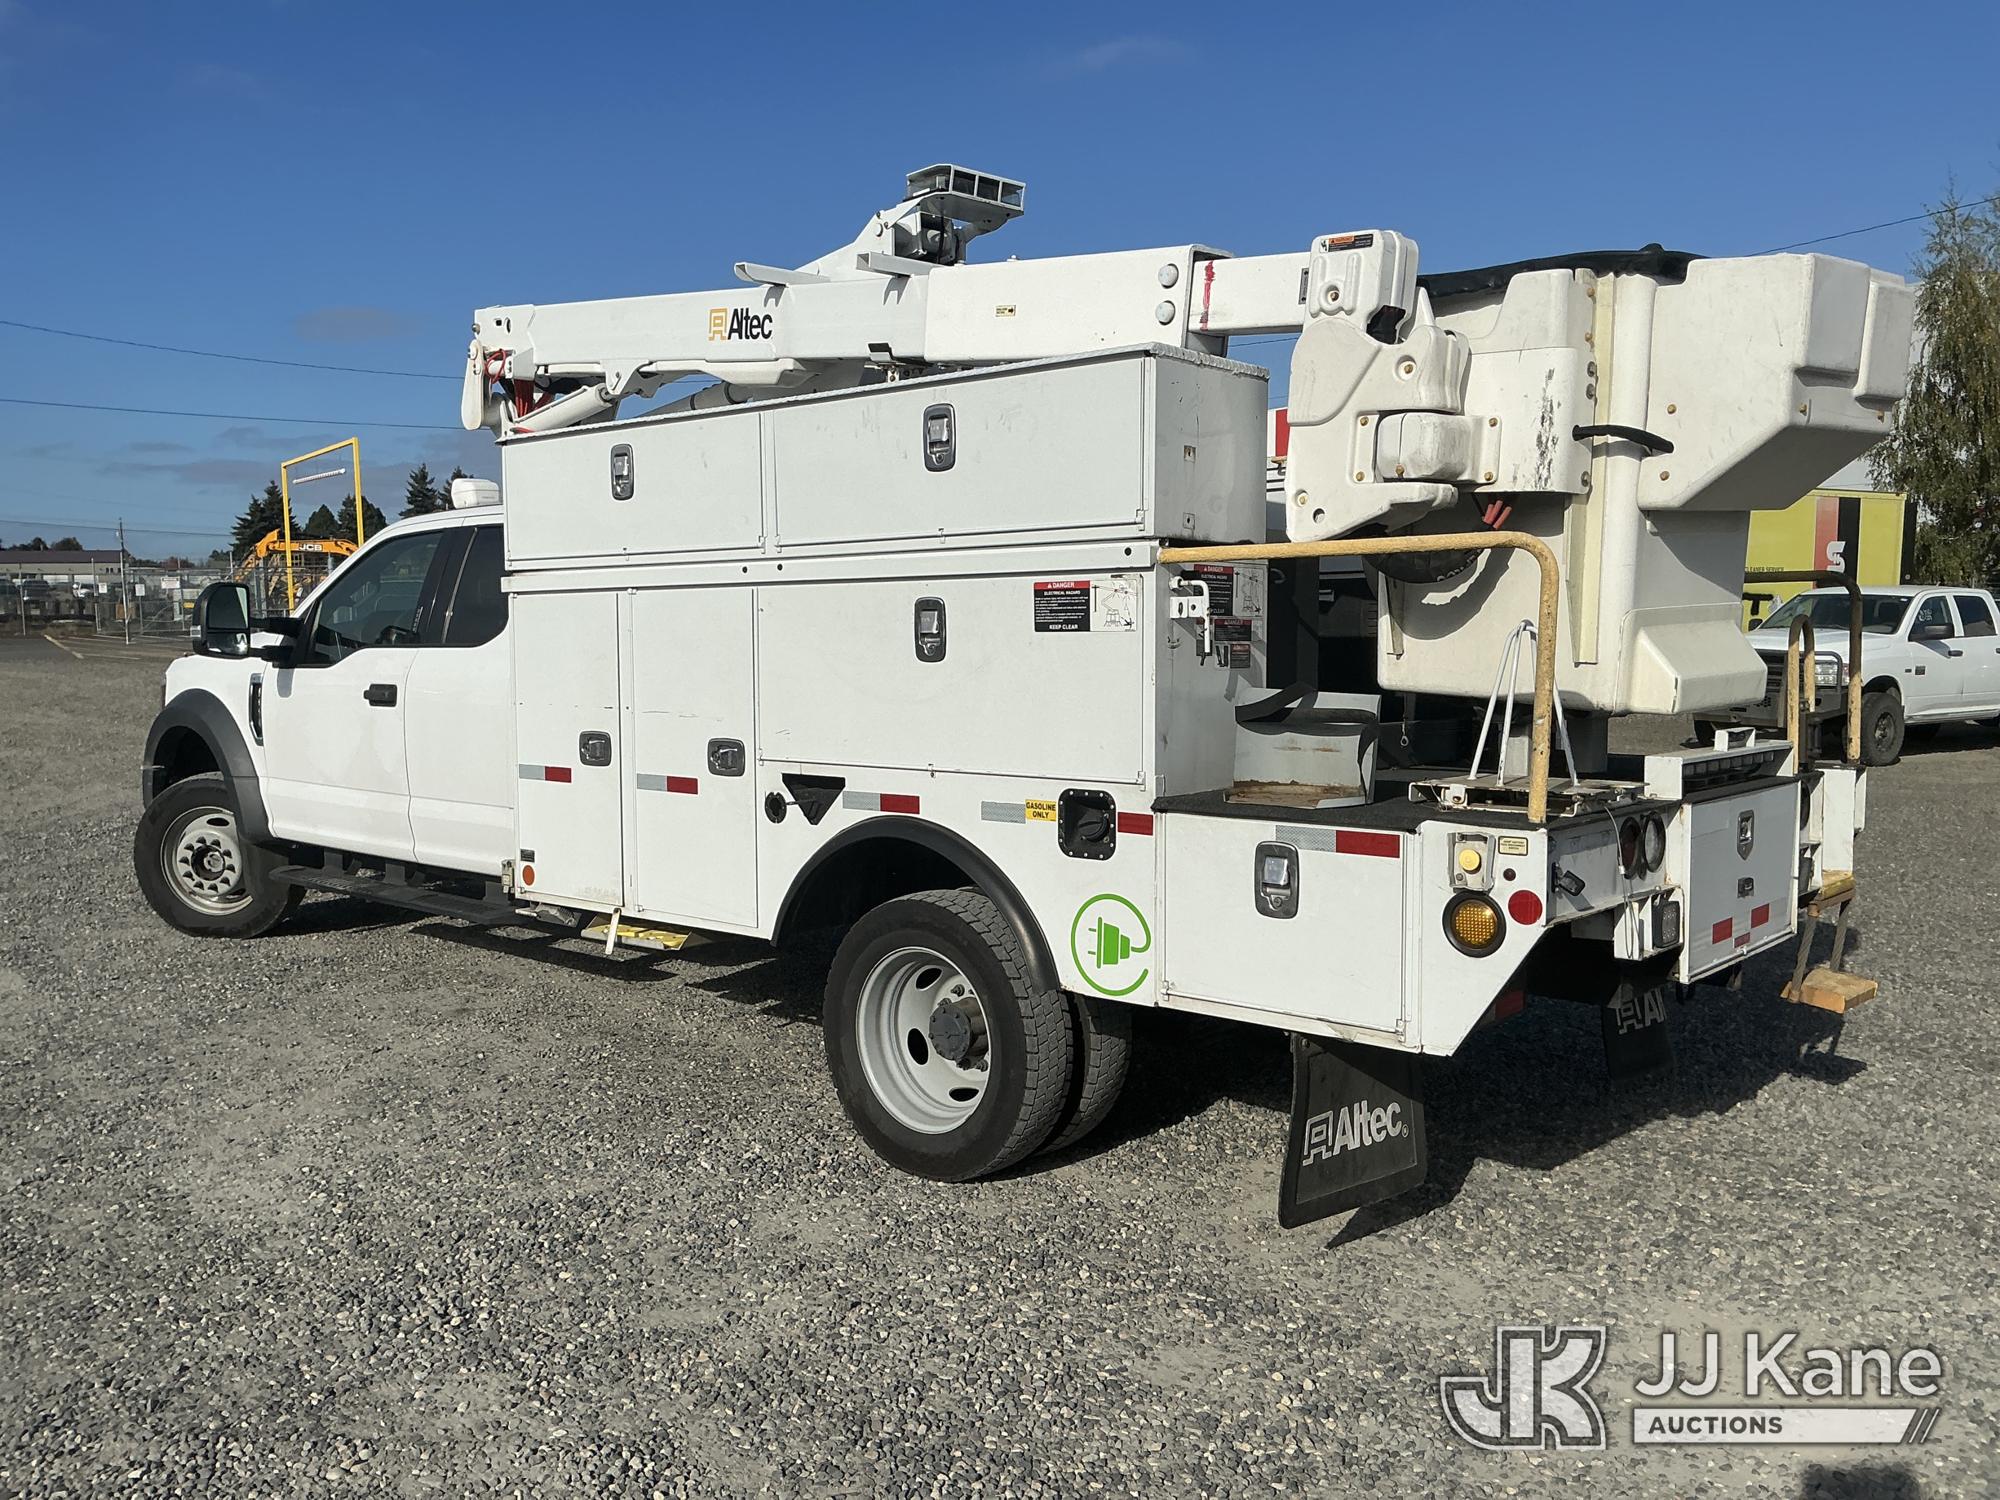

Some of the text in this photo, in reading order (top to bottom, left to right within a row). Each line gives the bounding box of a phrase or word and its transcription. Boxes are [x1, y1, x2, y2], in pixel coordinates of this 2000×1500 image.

[727, 307, 773, 340] Altec
[299, 543, 322, 551] JCB
[1026, 801, 1056, 811] GASOLINE
[1032, 810, 1050, 819] ONLY
[1332, 1099, 1402, 1156] Altec
